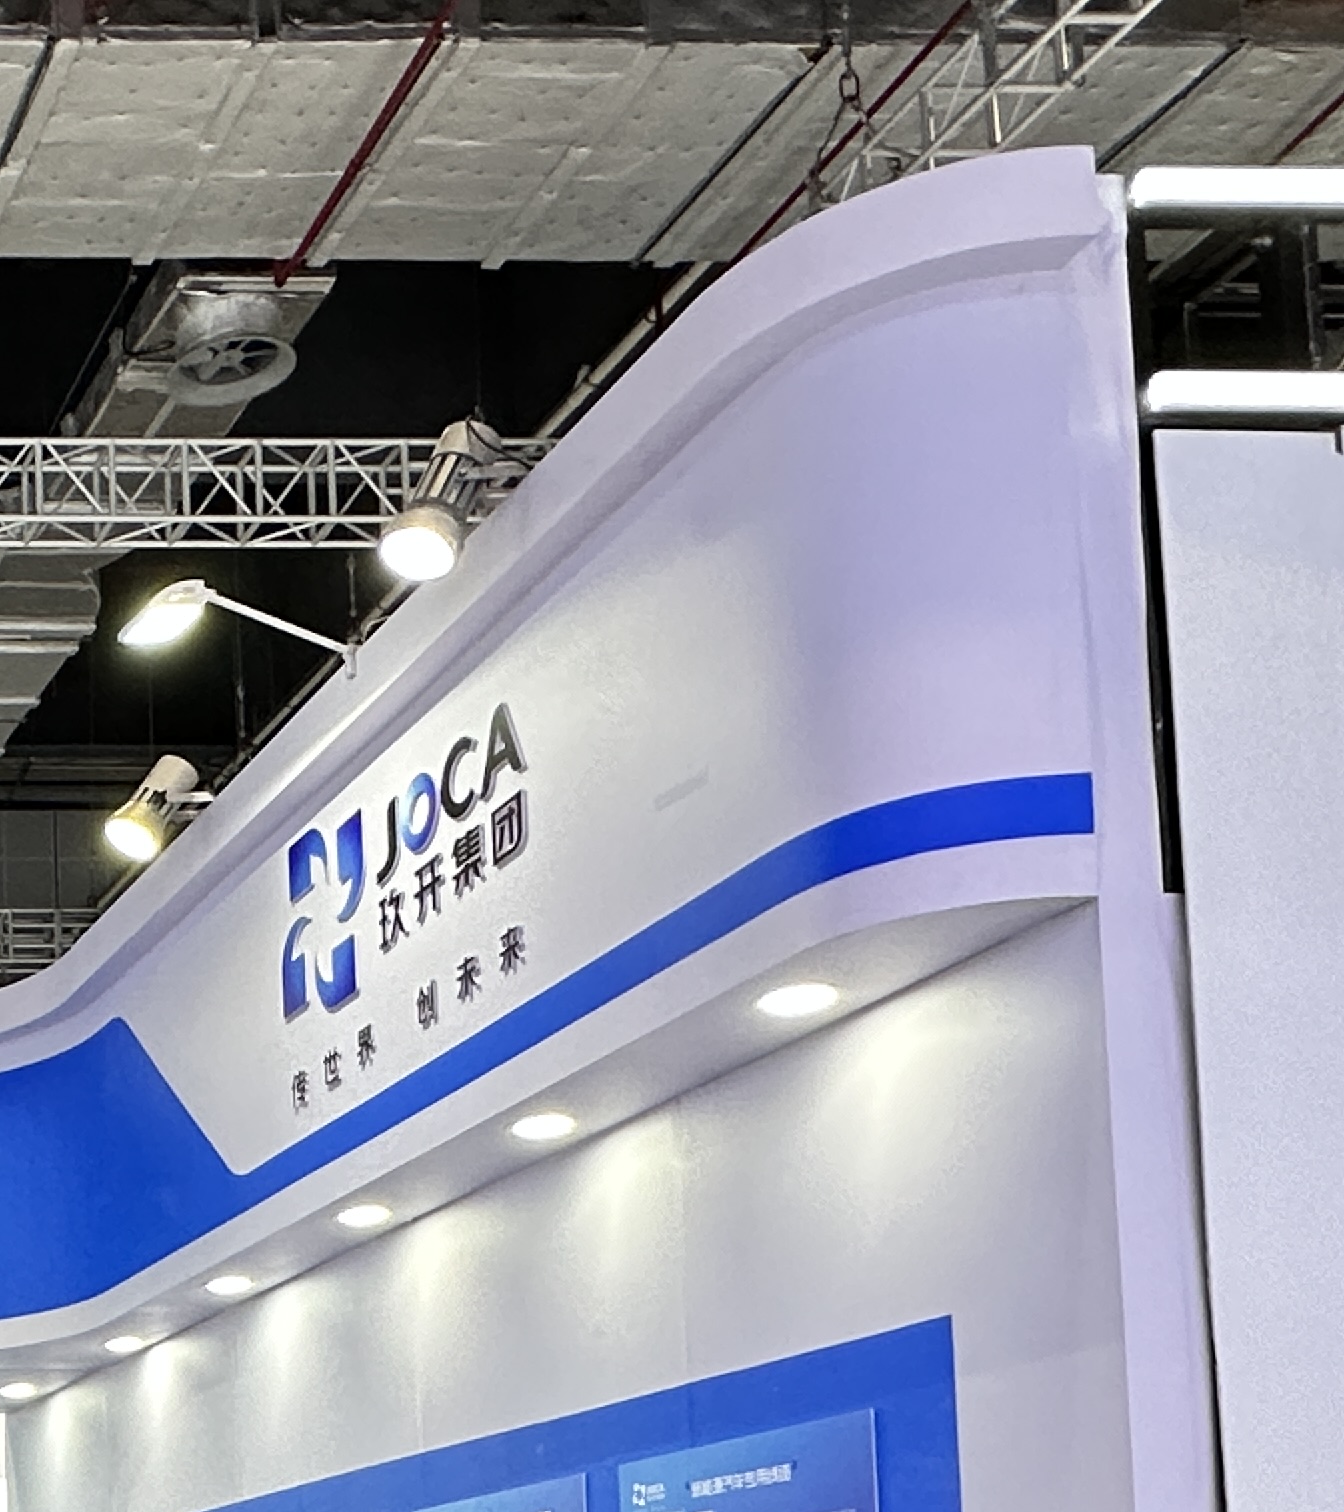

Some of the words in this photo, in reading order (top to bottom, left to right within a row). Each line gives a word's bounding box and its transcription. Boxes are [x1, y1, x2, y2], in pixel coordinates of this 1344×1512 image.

[376, 702, 529, 888] JOCA
[379, 790, 529, 953] 玖开集团
[291, 1024, 377, 1111] 传世界
[416, 925, 528, 1030] 创未来
